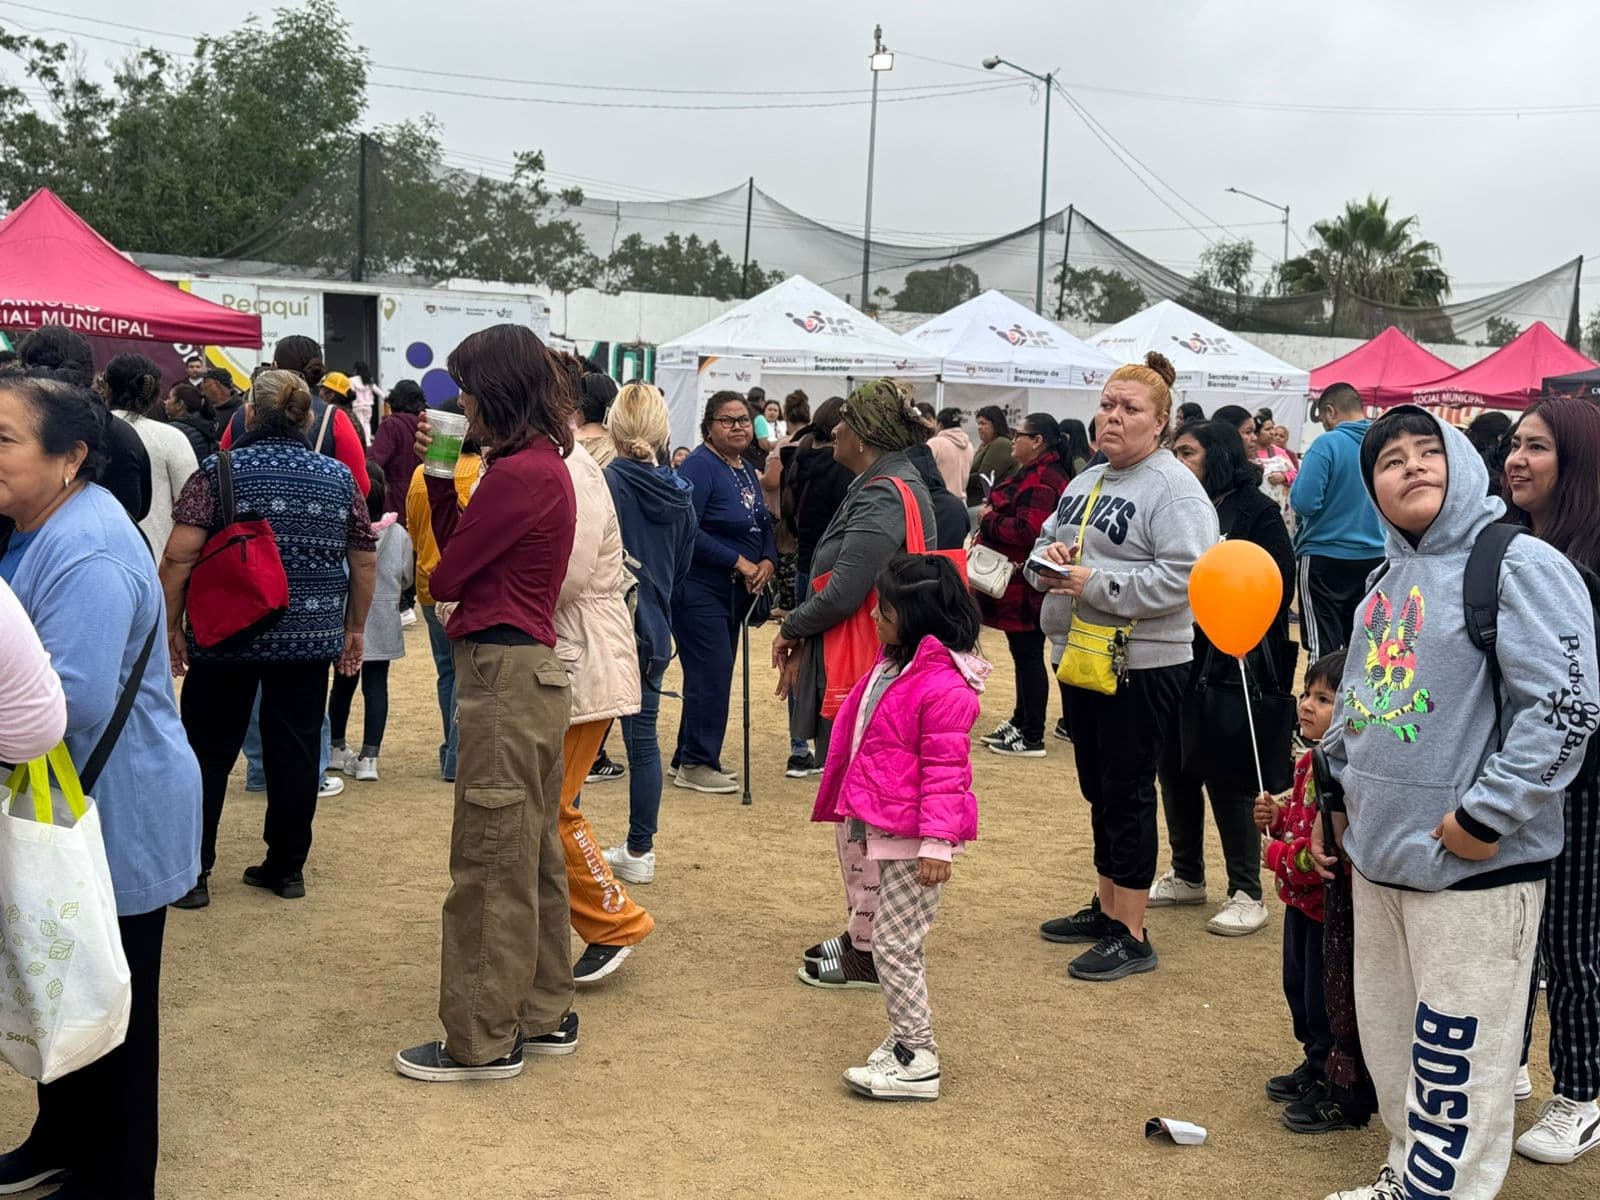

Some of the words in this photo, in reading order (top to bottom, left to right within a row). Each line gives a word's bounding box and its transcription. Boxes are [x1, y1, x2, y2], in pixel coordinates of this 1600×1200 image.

[221, 294, 309, 319] Reaquí
[0, 309, 36, 325] IAL
[41, 310, 155, 338] MUNICIPAL
[1013, 375, 1046, 384] Bienestar
[1441, 392, 1486, 404] MUNICIPAL
[573, 829, 615, 895] APERTURE
